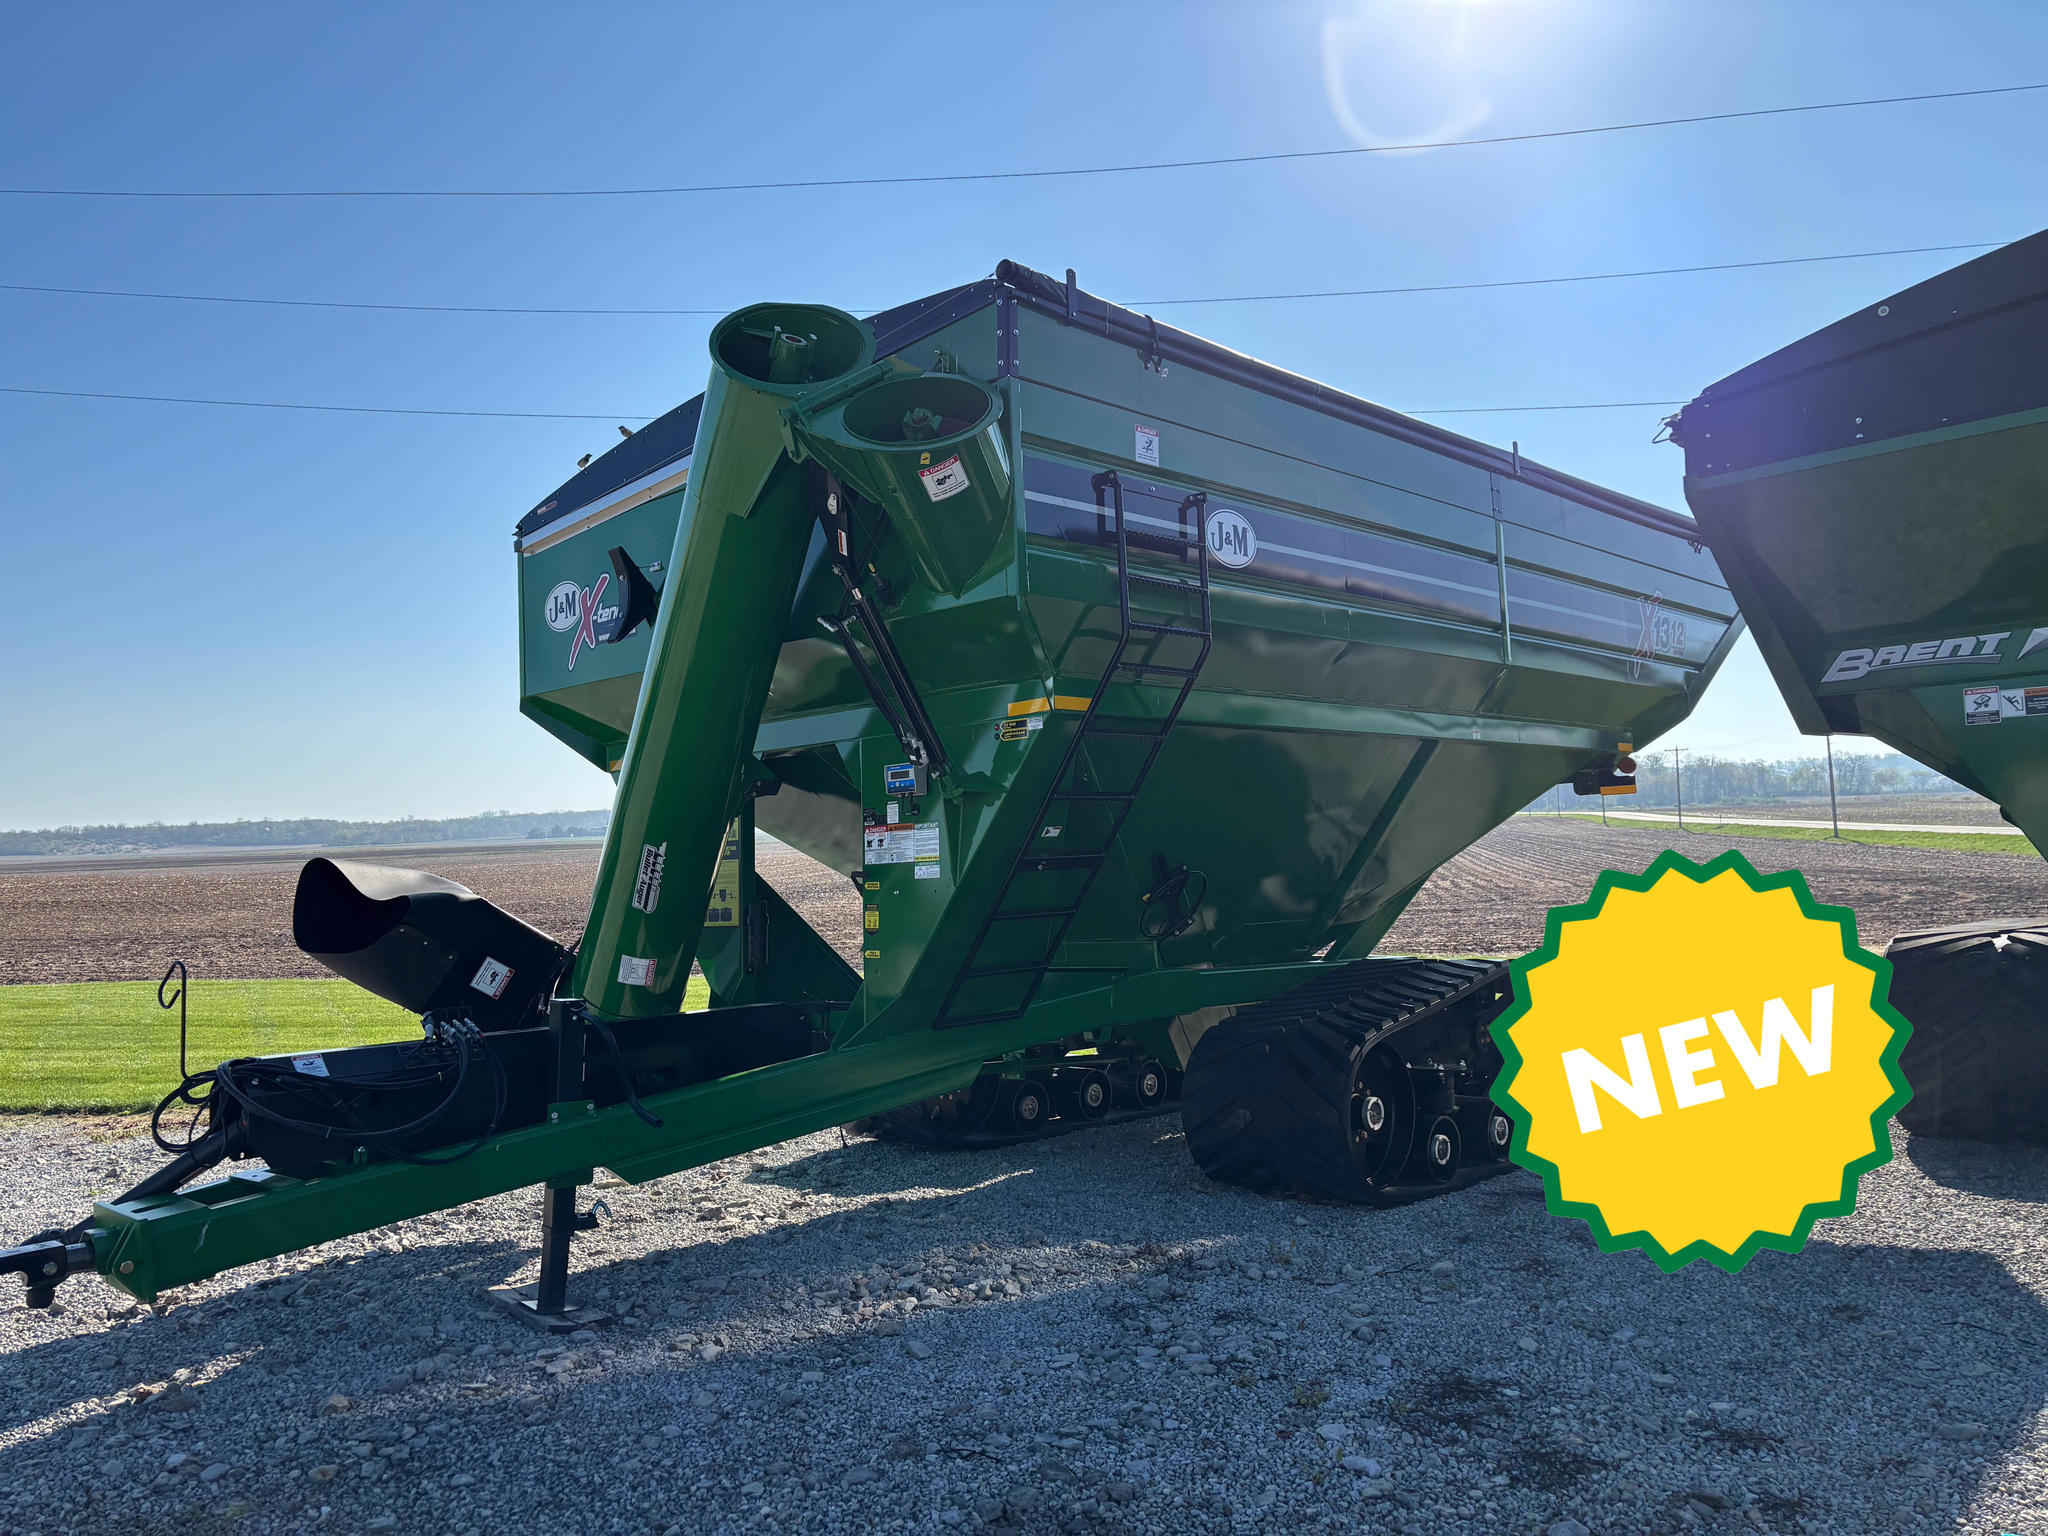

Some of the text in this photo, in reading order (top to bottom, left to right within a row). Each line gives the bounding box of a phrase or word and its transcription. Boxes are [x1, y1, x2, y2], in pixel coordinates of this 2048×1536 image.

[930, 458, 955, 473] DANGER
[1211, 521, 1249, 557] J&M
[549, 590, 578, 623] J&M
[1820, 631, 2011, 683] BRENT
[1972, 687, 1997, 695] DANGER
[893, 824, 913, 832] WARNING
[636, 848, 654, 907] Bullet Auger
[495, 976, 509, 996] DANGER
